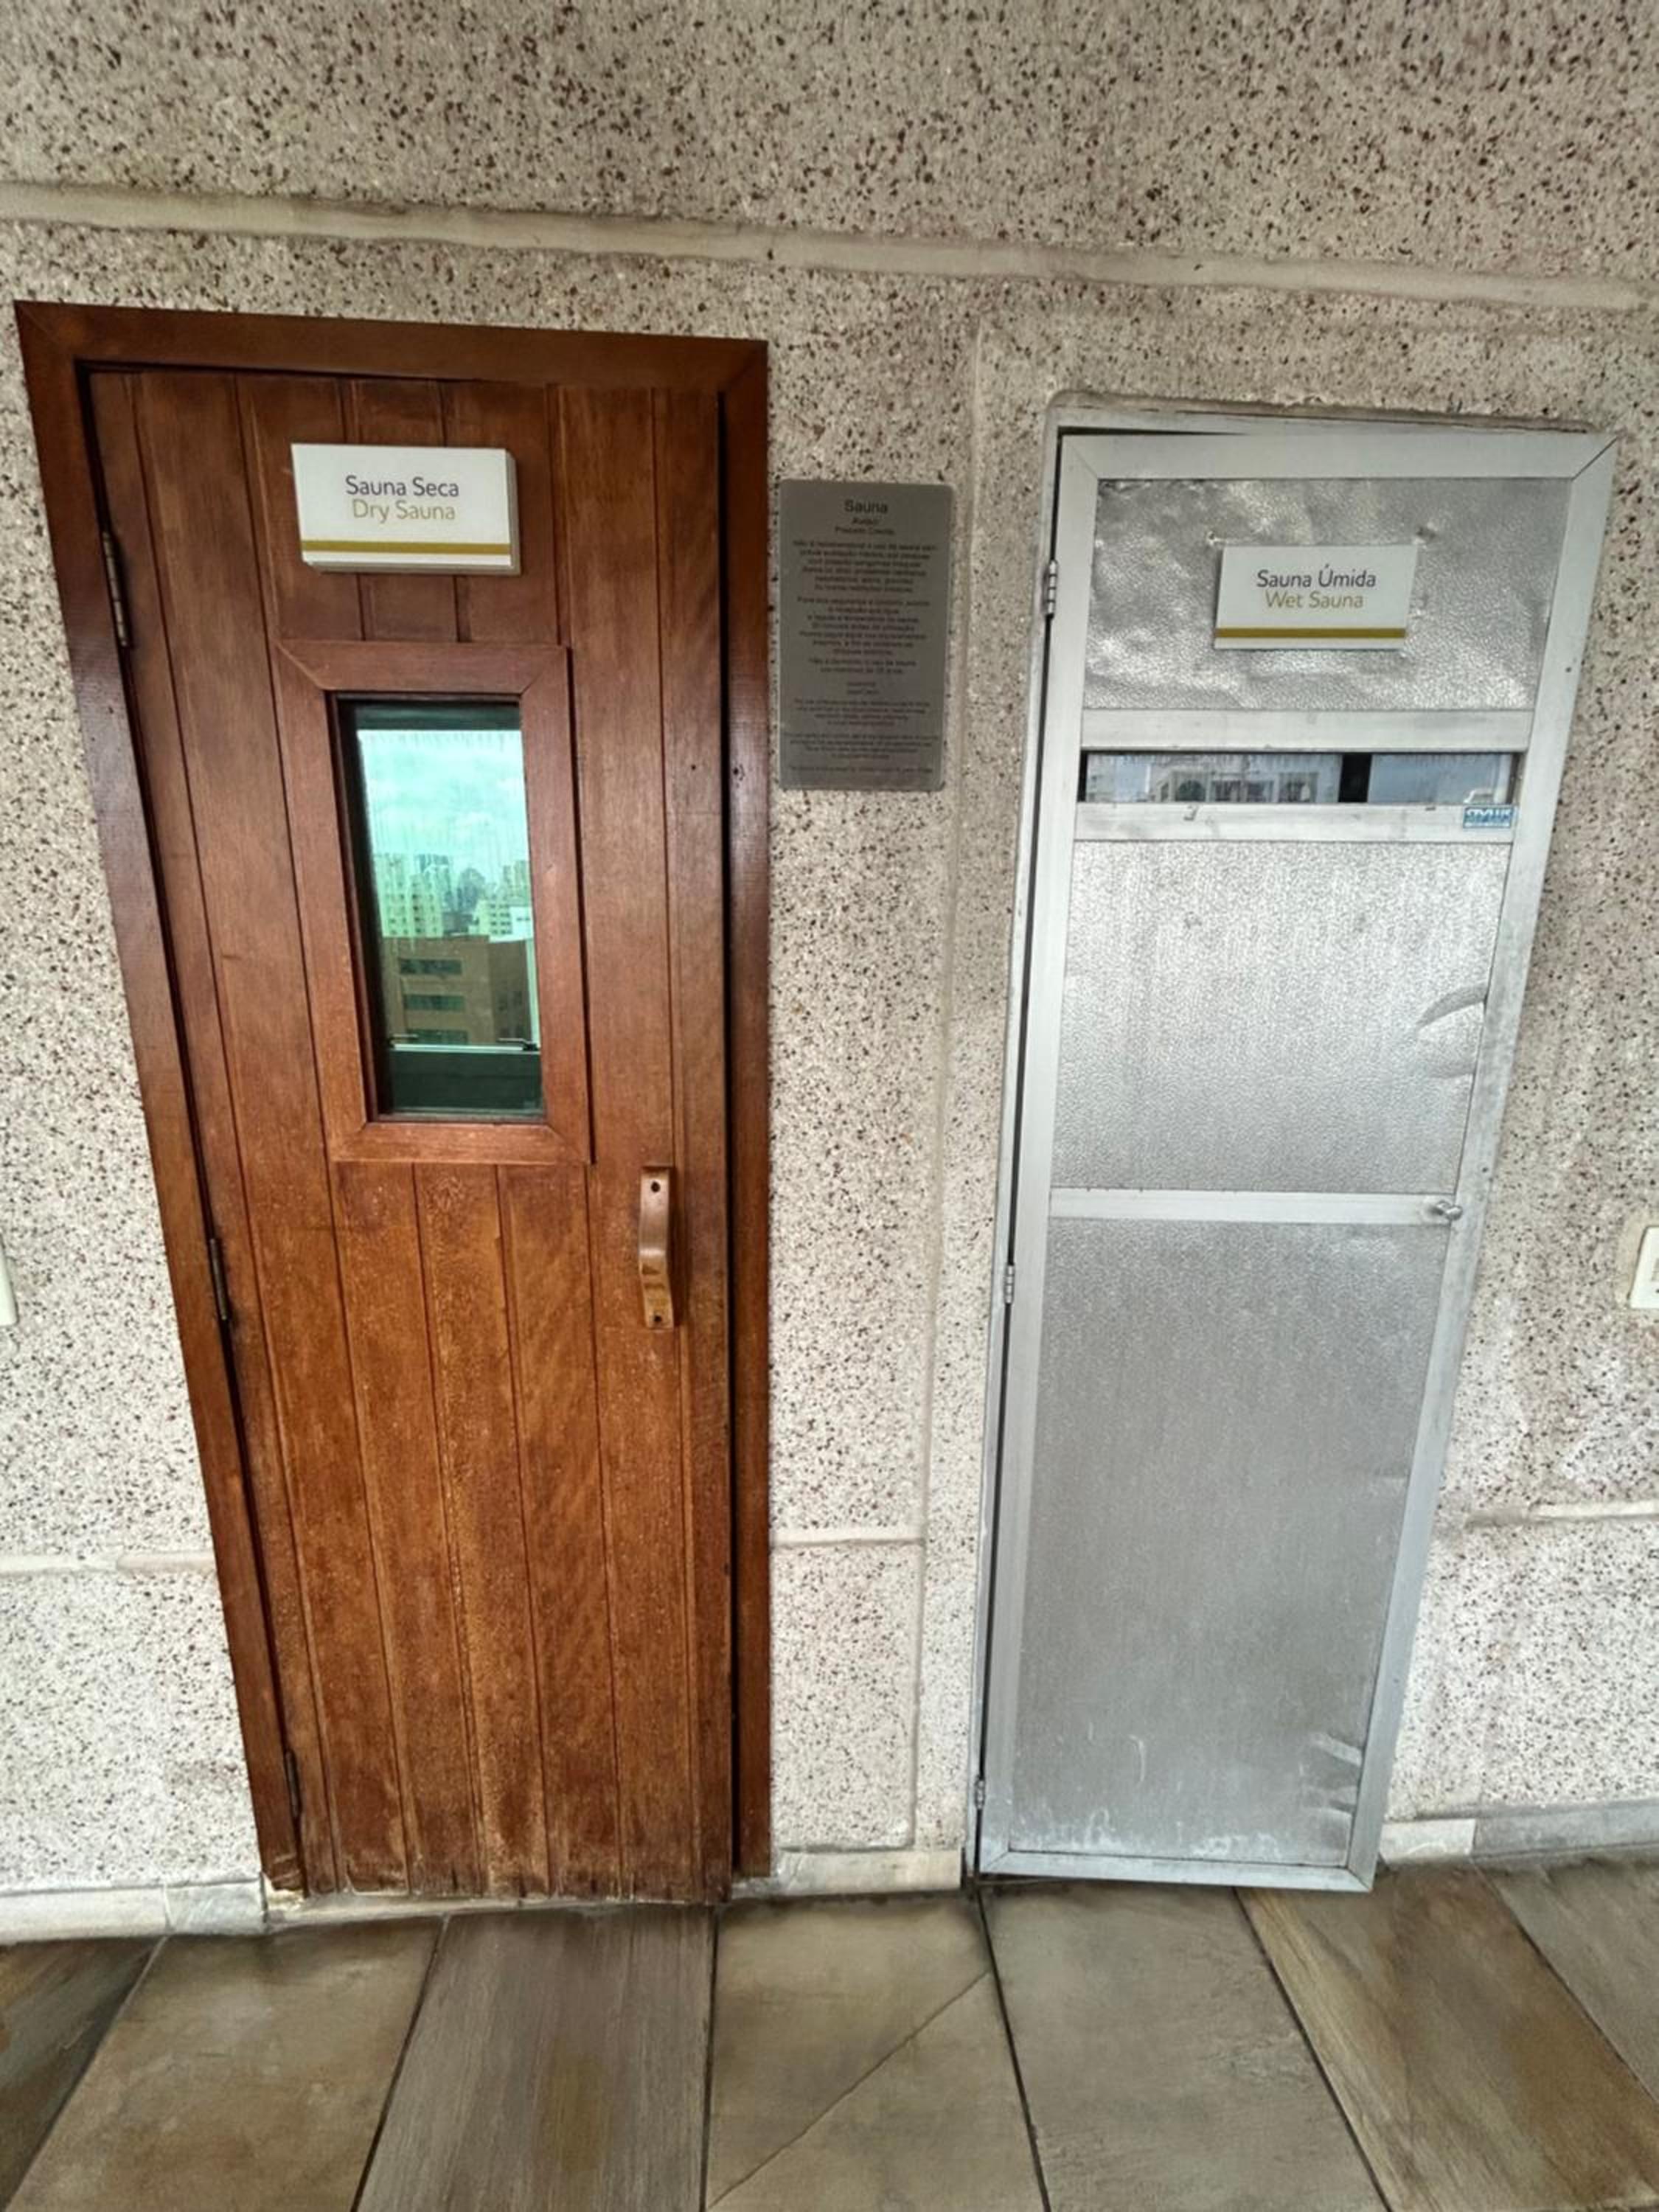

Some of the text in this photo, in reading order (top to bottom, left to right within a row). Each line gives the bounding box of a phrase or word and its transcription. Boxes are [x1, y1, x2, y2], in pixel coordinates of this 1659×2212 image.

[345, 474, 459, 497] Sauna Seca
[352, 498, 456, 524] Dry Sauna
[844, 499, 888, 515] Sauna
[1256, 563, 1377, 588] Sauna Úmida
[1265, 591, 1364, 609] Wet Sauna
